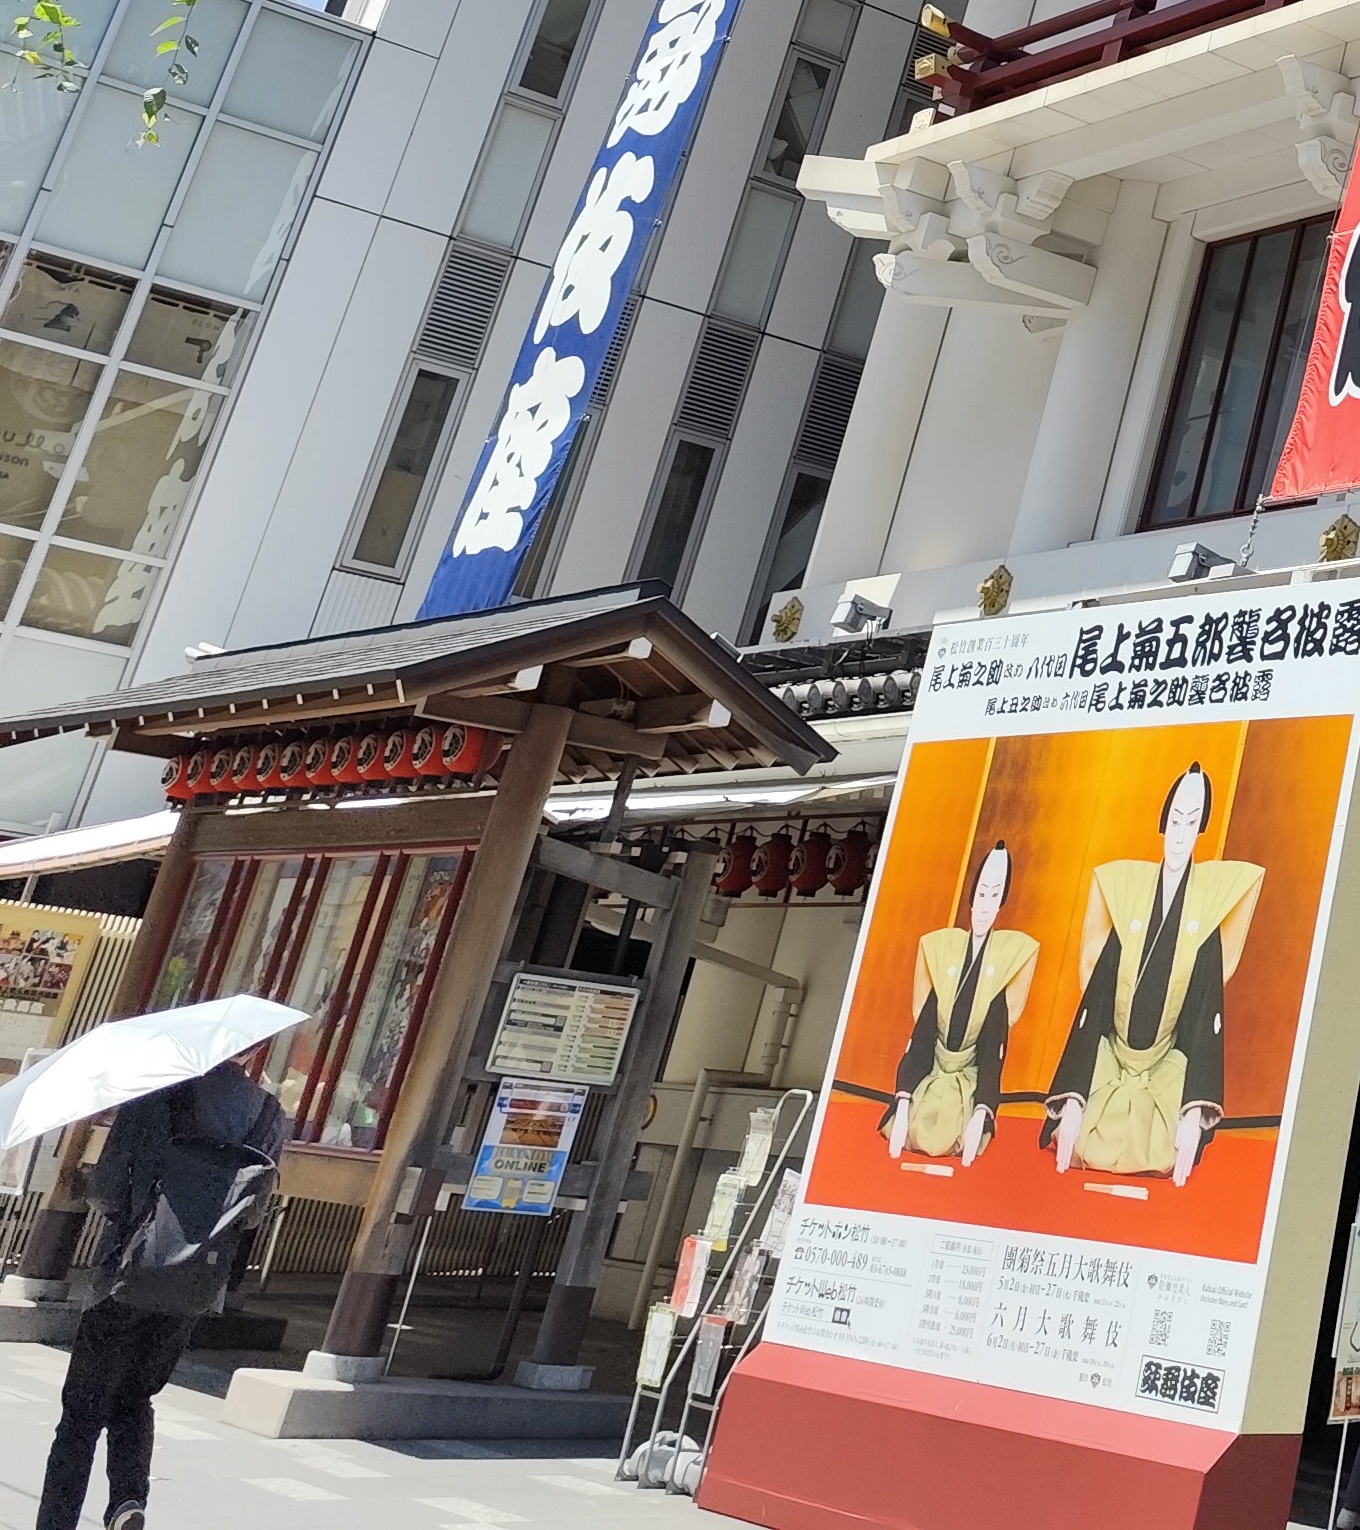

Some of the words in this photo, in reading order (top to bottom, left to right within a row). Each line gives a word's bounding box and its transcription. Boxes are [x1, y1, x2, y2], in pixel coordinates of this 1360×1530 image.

[494, 1159, 547, 1174] ONLINE
[800, 1217, 871, 1244] チケットホン松竹
[805, 1246, 869, 1272] 0570-000-489
[1002, 1245, 1133, 1289] 團菊祭五月大歌舞伎
[990, 1302, 1122, 1348] 六月大歌舞伎
